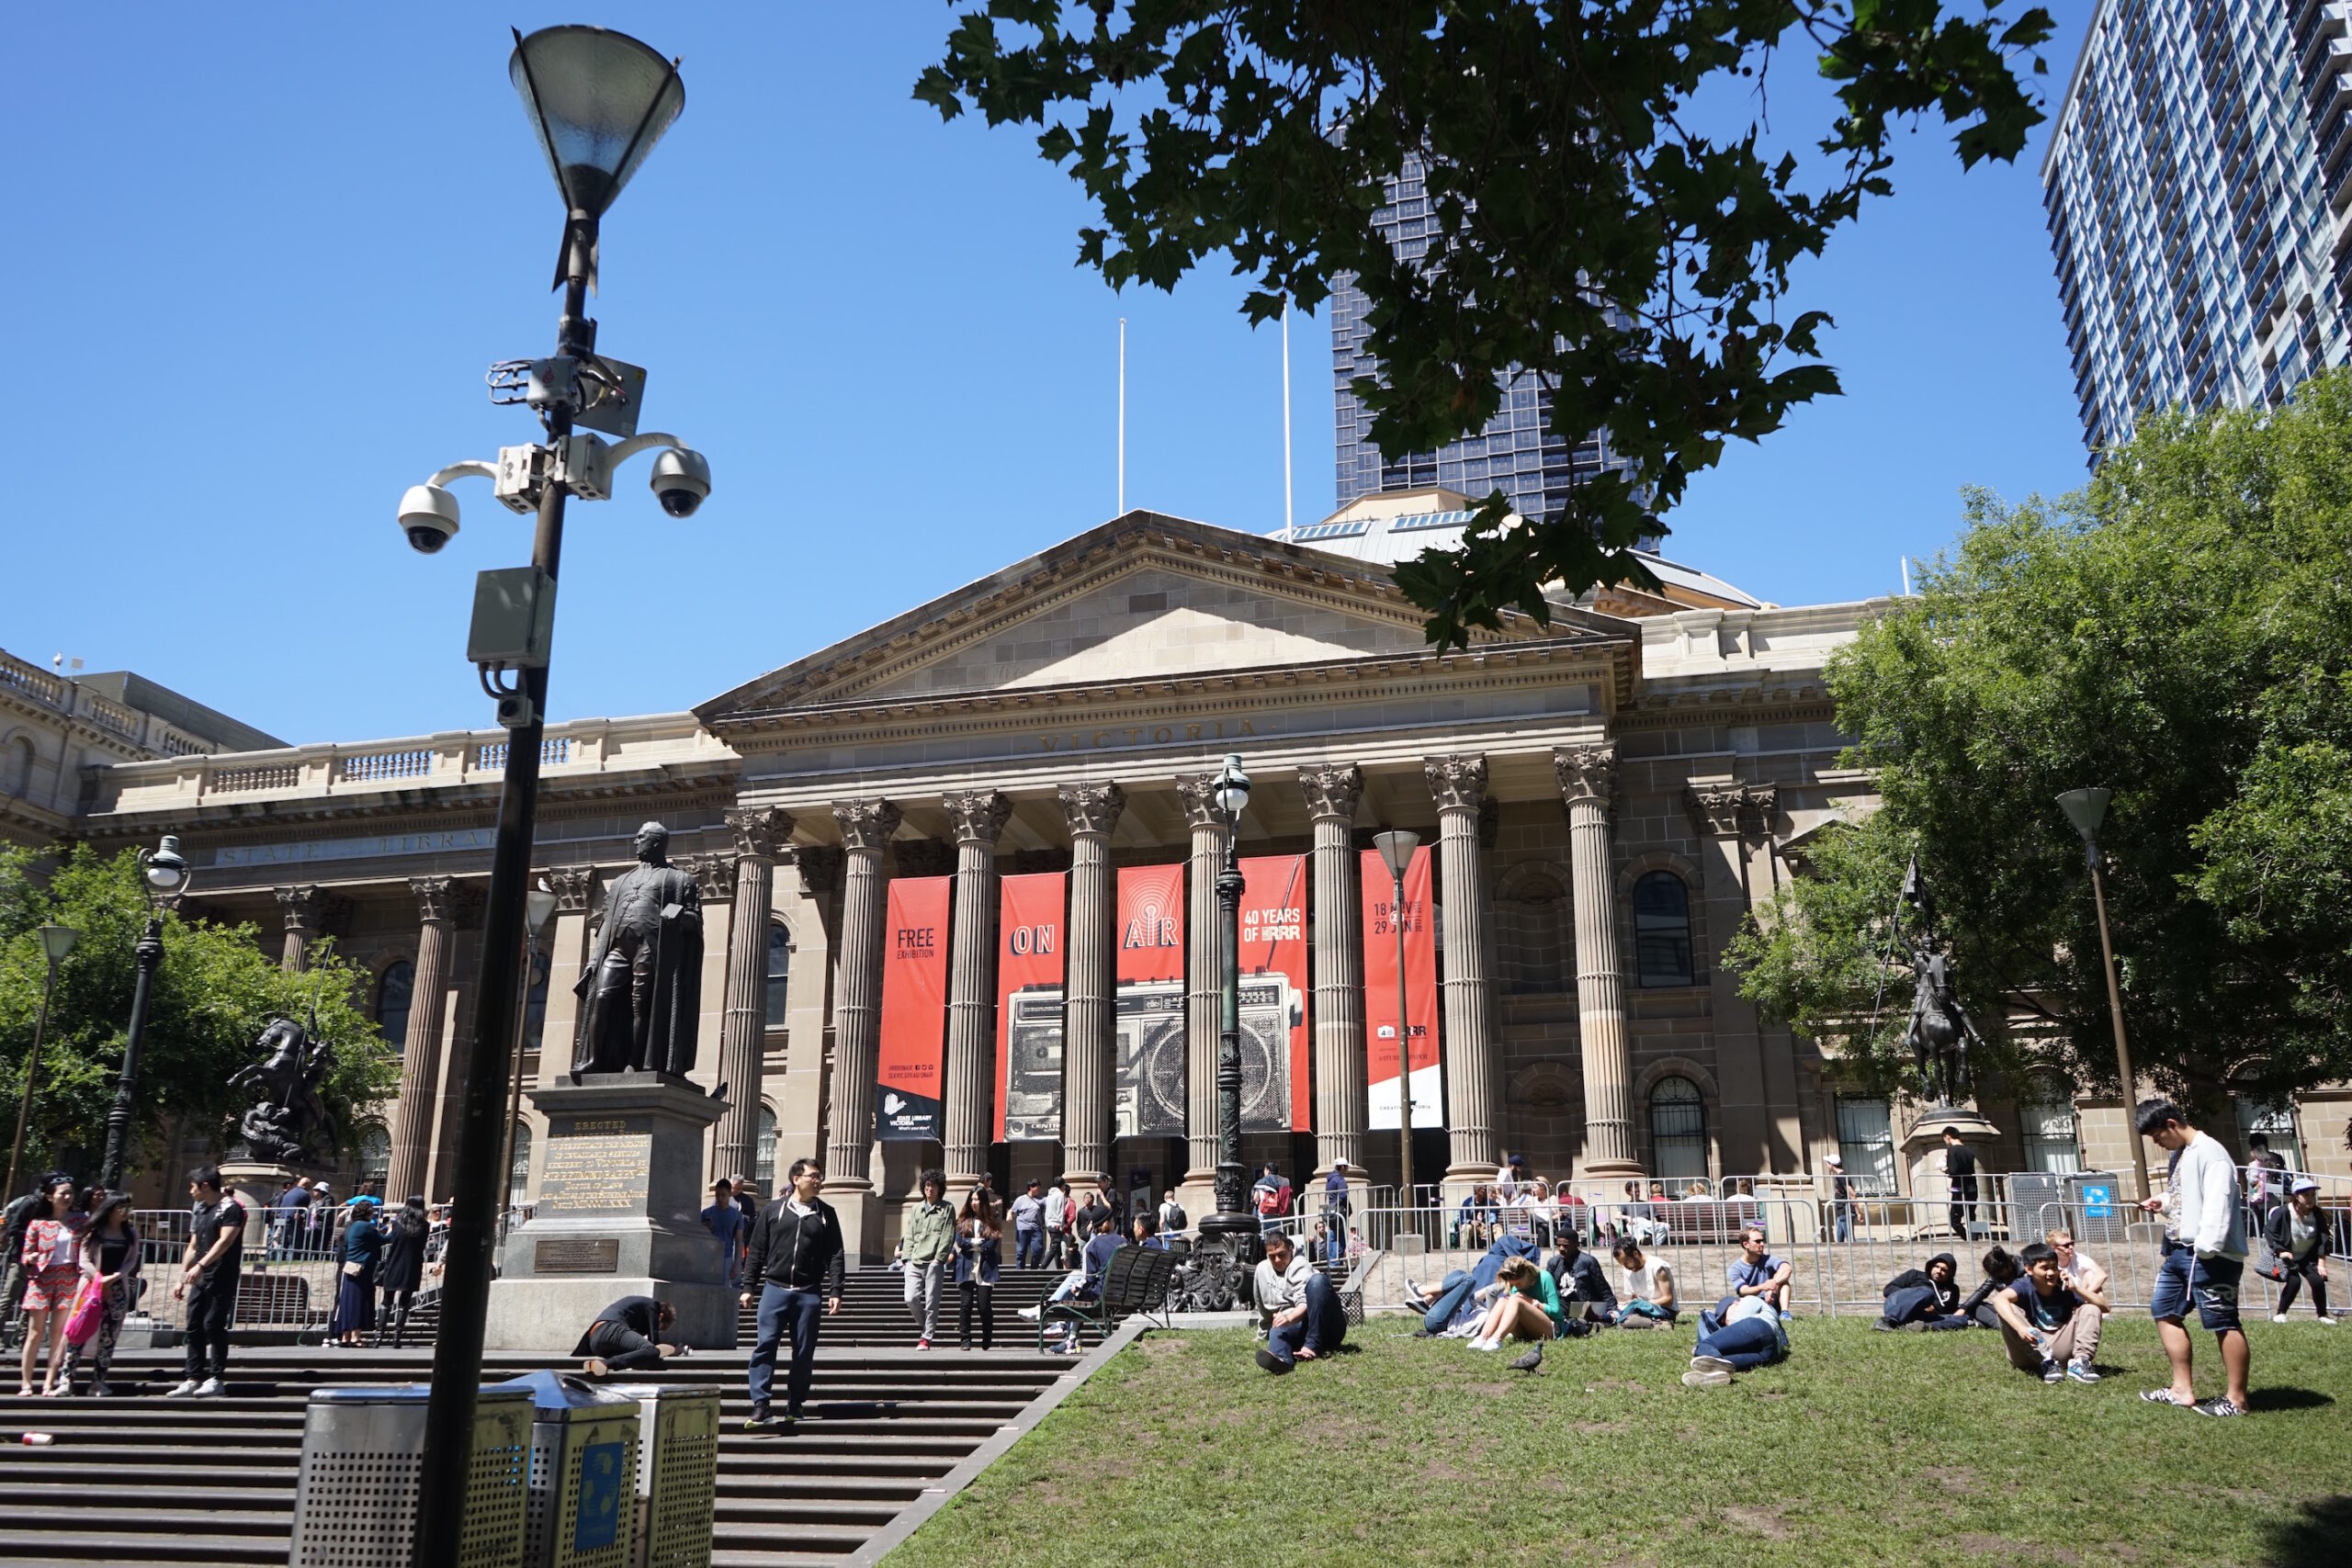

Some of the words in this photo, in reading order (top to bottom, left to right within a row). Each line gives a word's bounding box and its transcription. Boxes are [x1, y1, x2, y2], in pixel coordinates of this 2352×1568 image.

[1038, 719, 1257, 752] VICTORIA
[224, 843, 319, 863] STATE
[381, 830, 497, 852] LIBRA
[1244, 909, 1260, 925] 40
[1261, 908, 1301, 924] YEARS
[1374, 902, 1386, 917] 18
[1390, 901, 1412, 915] NV
[1124, 913, 1180, 950] AIR
[1244, 927, 1260, 942] OF
[1374, 920, 1387, 934] 29
[1390, 919, 1412, 933] JN
[898, 928, 934, 948] FREE
[1011, 924, 1055, 956] ON
[897, 948, 934, 959] EXHIBITION
[574, 1121, 627, 1130] ERECTED
